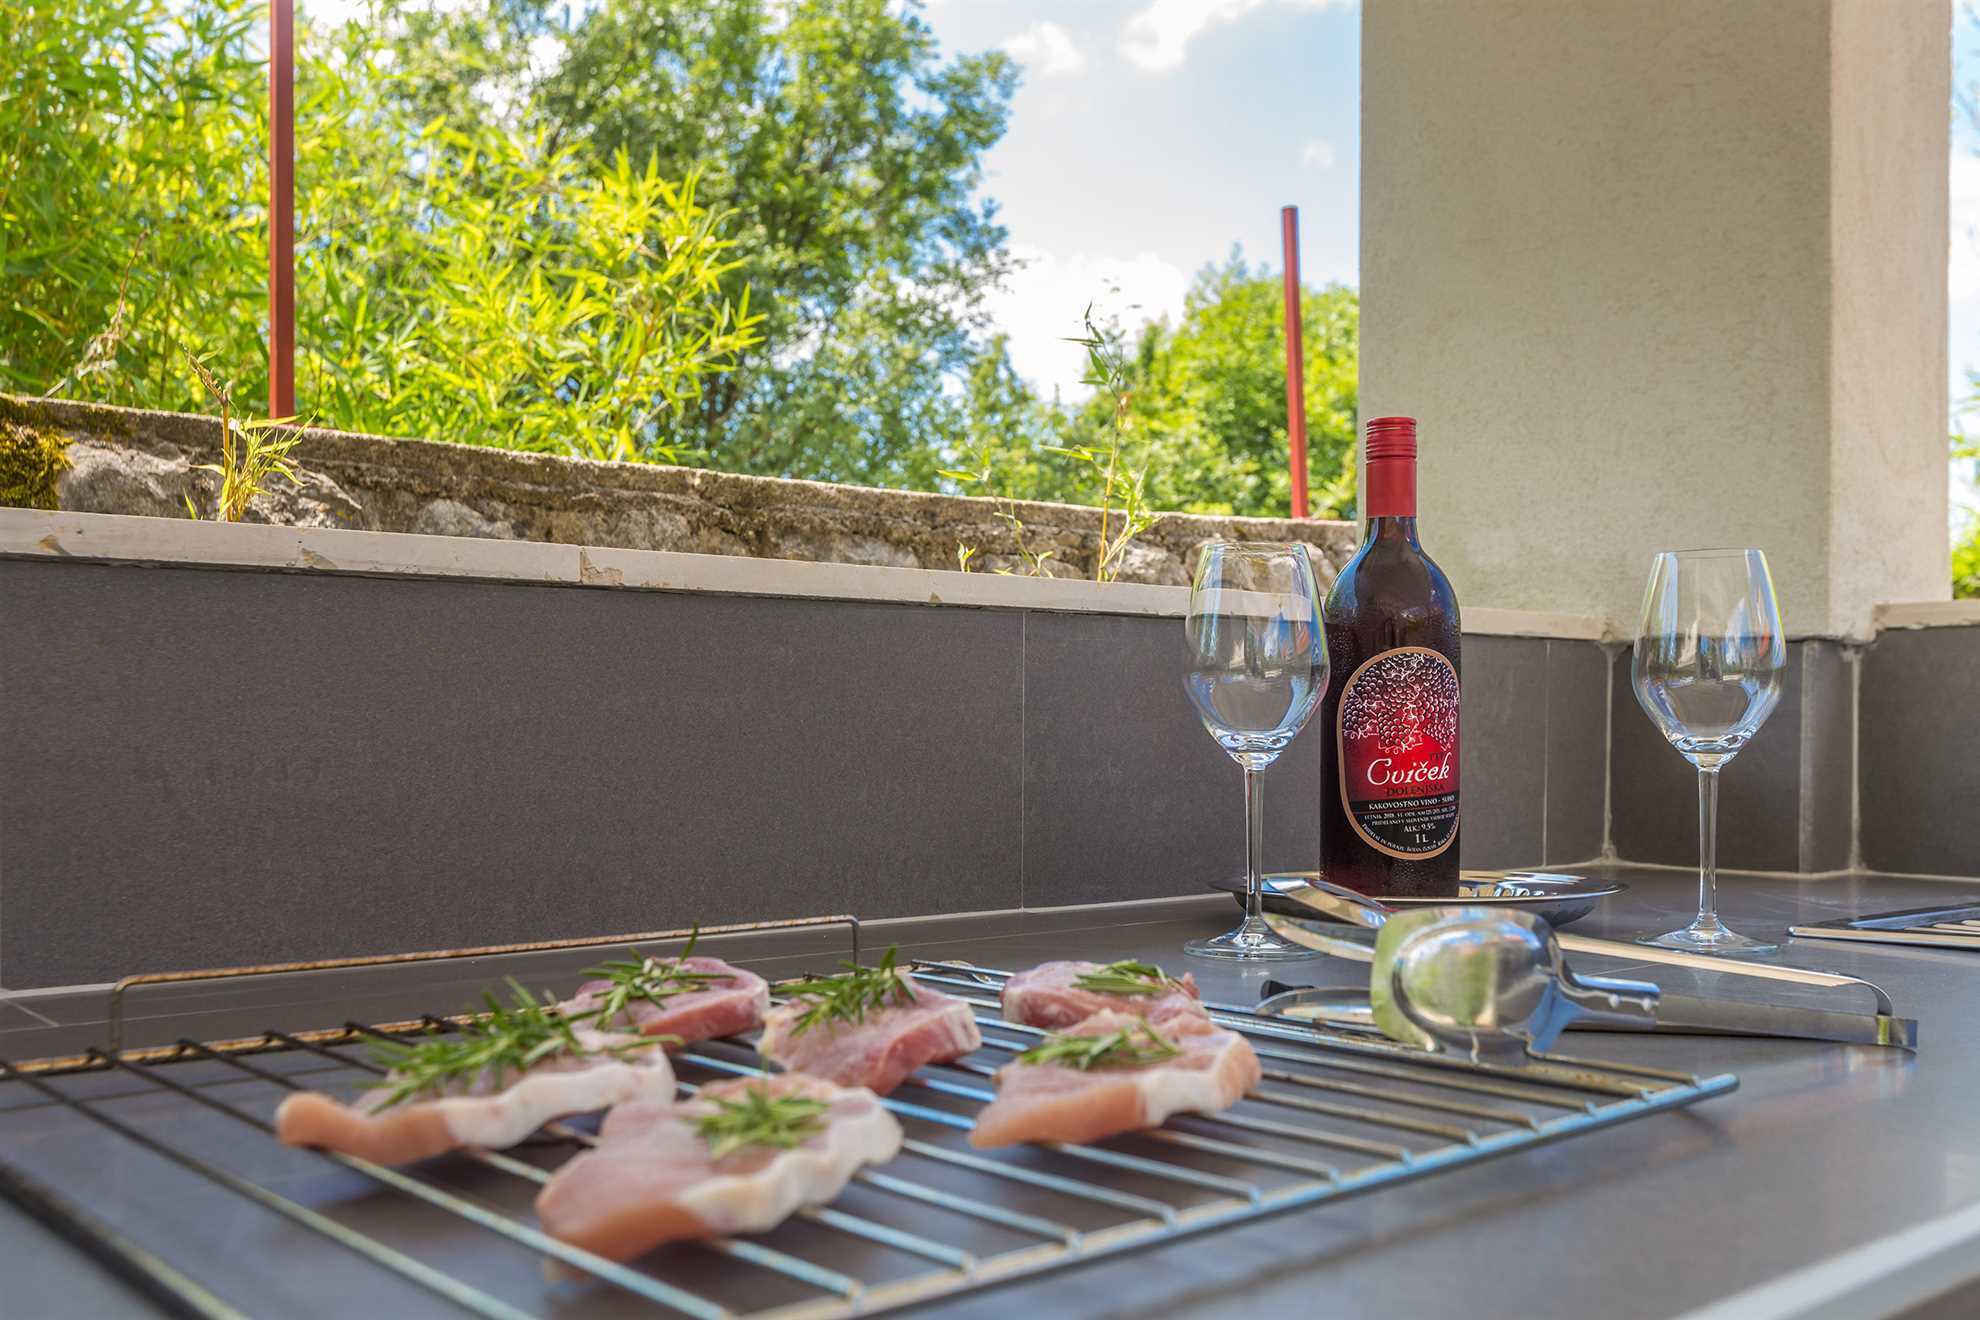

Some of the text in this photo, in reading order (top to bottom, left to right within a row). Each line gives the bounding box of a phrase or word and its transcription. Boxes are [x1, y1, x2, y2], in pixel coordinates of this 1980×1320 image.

[1367, 752, 1452, 785] Cviček
[1368, 799, 1419, 810] KAKOVOSTNO
[1420, 797, 1437, 807] VINO
